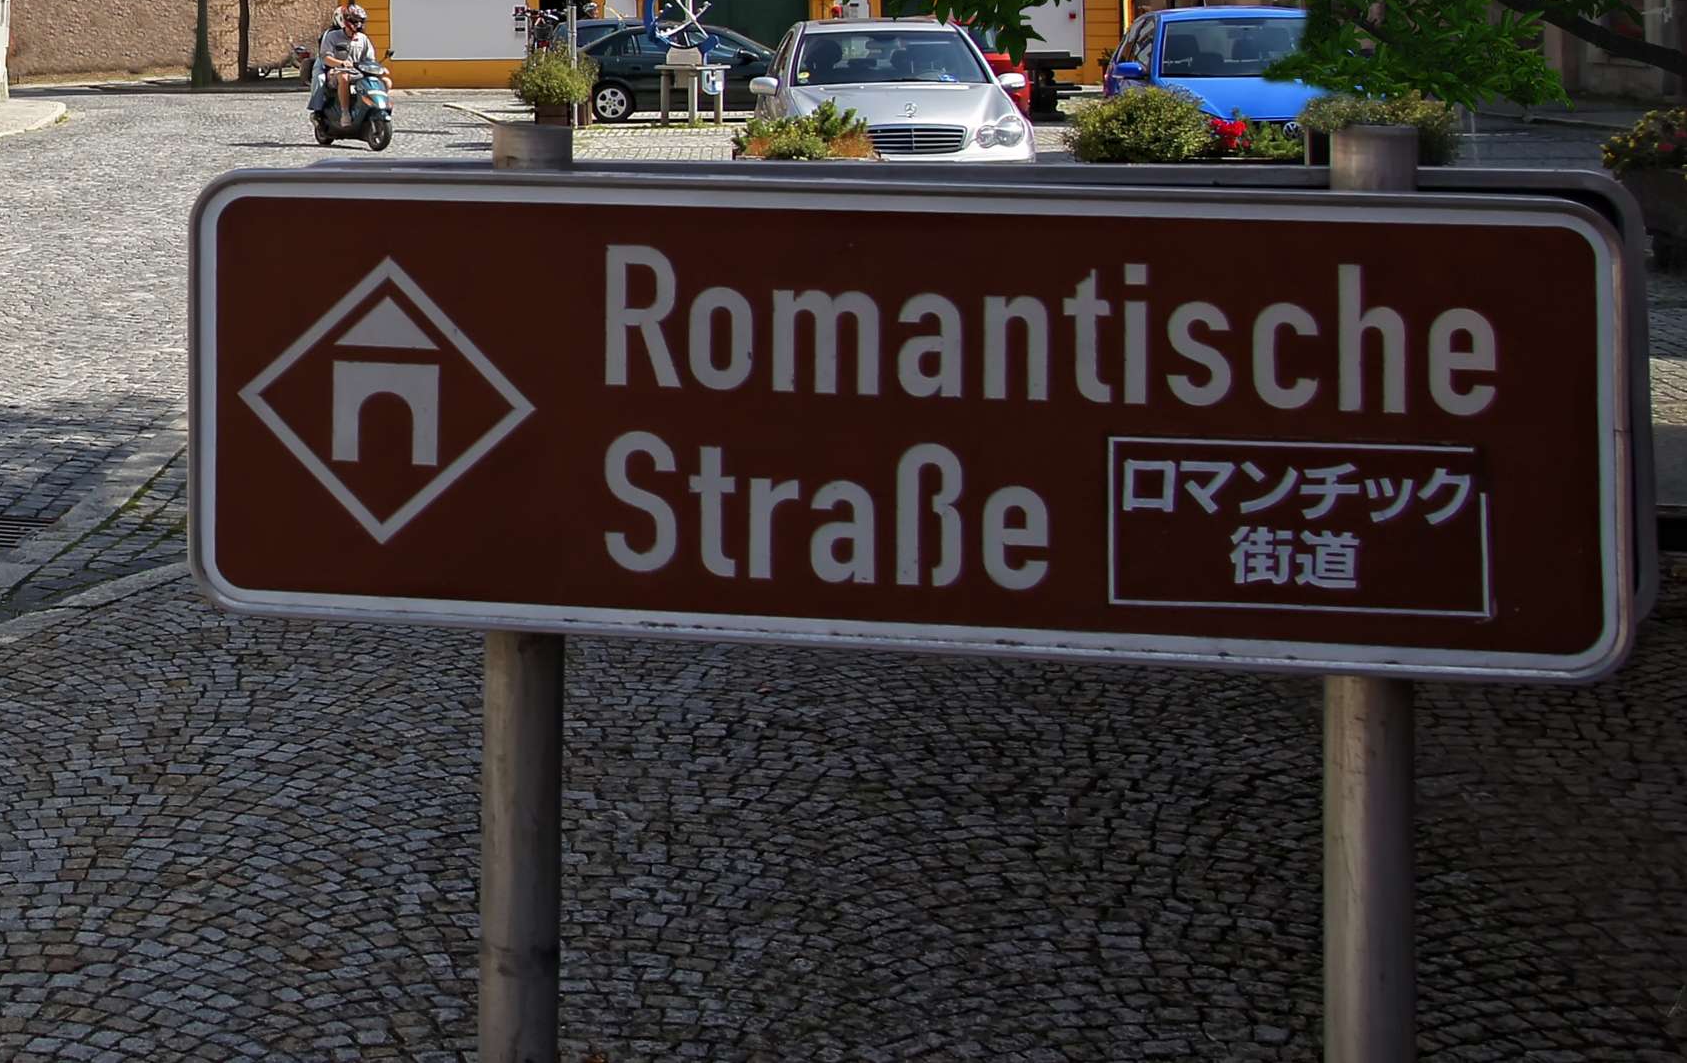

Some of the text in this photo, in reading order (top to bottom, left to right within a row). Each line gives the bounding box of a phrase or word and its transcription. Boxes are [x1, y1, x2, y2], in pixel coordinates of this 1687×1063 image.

[605, 244, 1497, 417] Romantische
[604, 431, 1049, 591] Straße
[1122, 458, 1471, 525] ロマンチック
[1229, 525, 1360, 589] 街道
